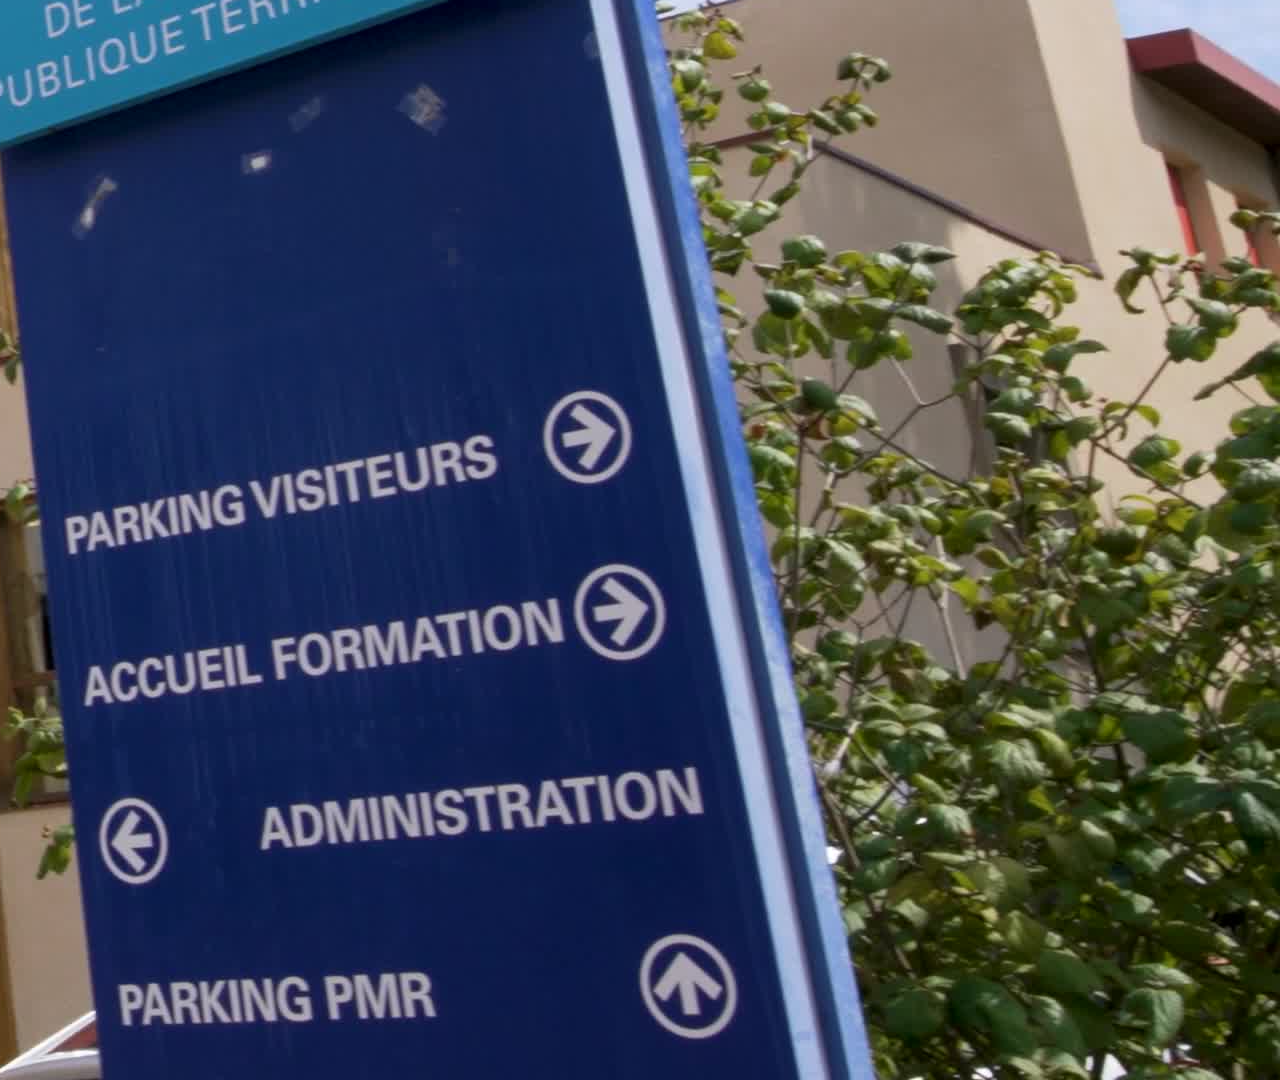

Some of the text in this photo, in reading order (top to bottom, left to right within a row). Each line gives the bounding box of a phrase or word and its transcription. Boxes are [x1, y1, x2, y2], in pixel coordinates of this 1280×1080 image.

[65, 435, 497, 555] PARKING VISITEURS
[83, 599, 564, 707] ACCUEIL FORMATION
[259, 767, 704, 851] ADMINISTRATION
[118, 972, 436, 1026] PARKING PMR
